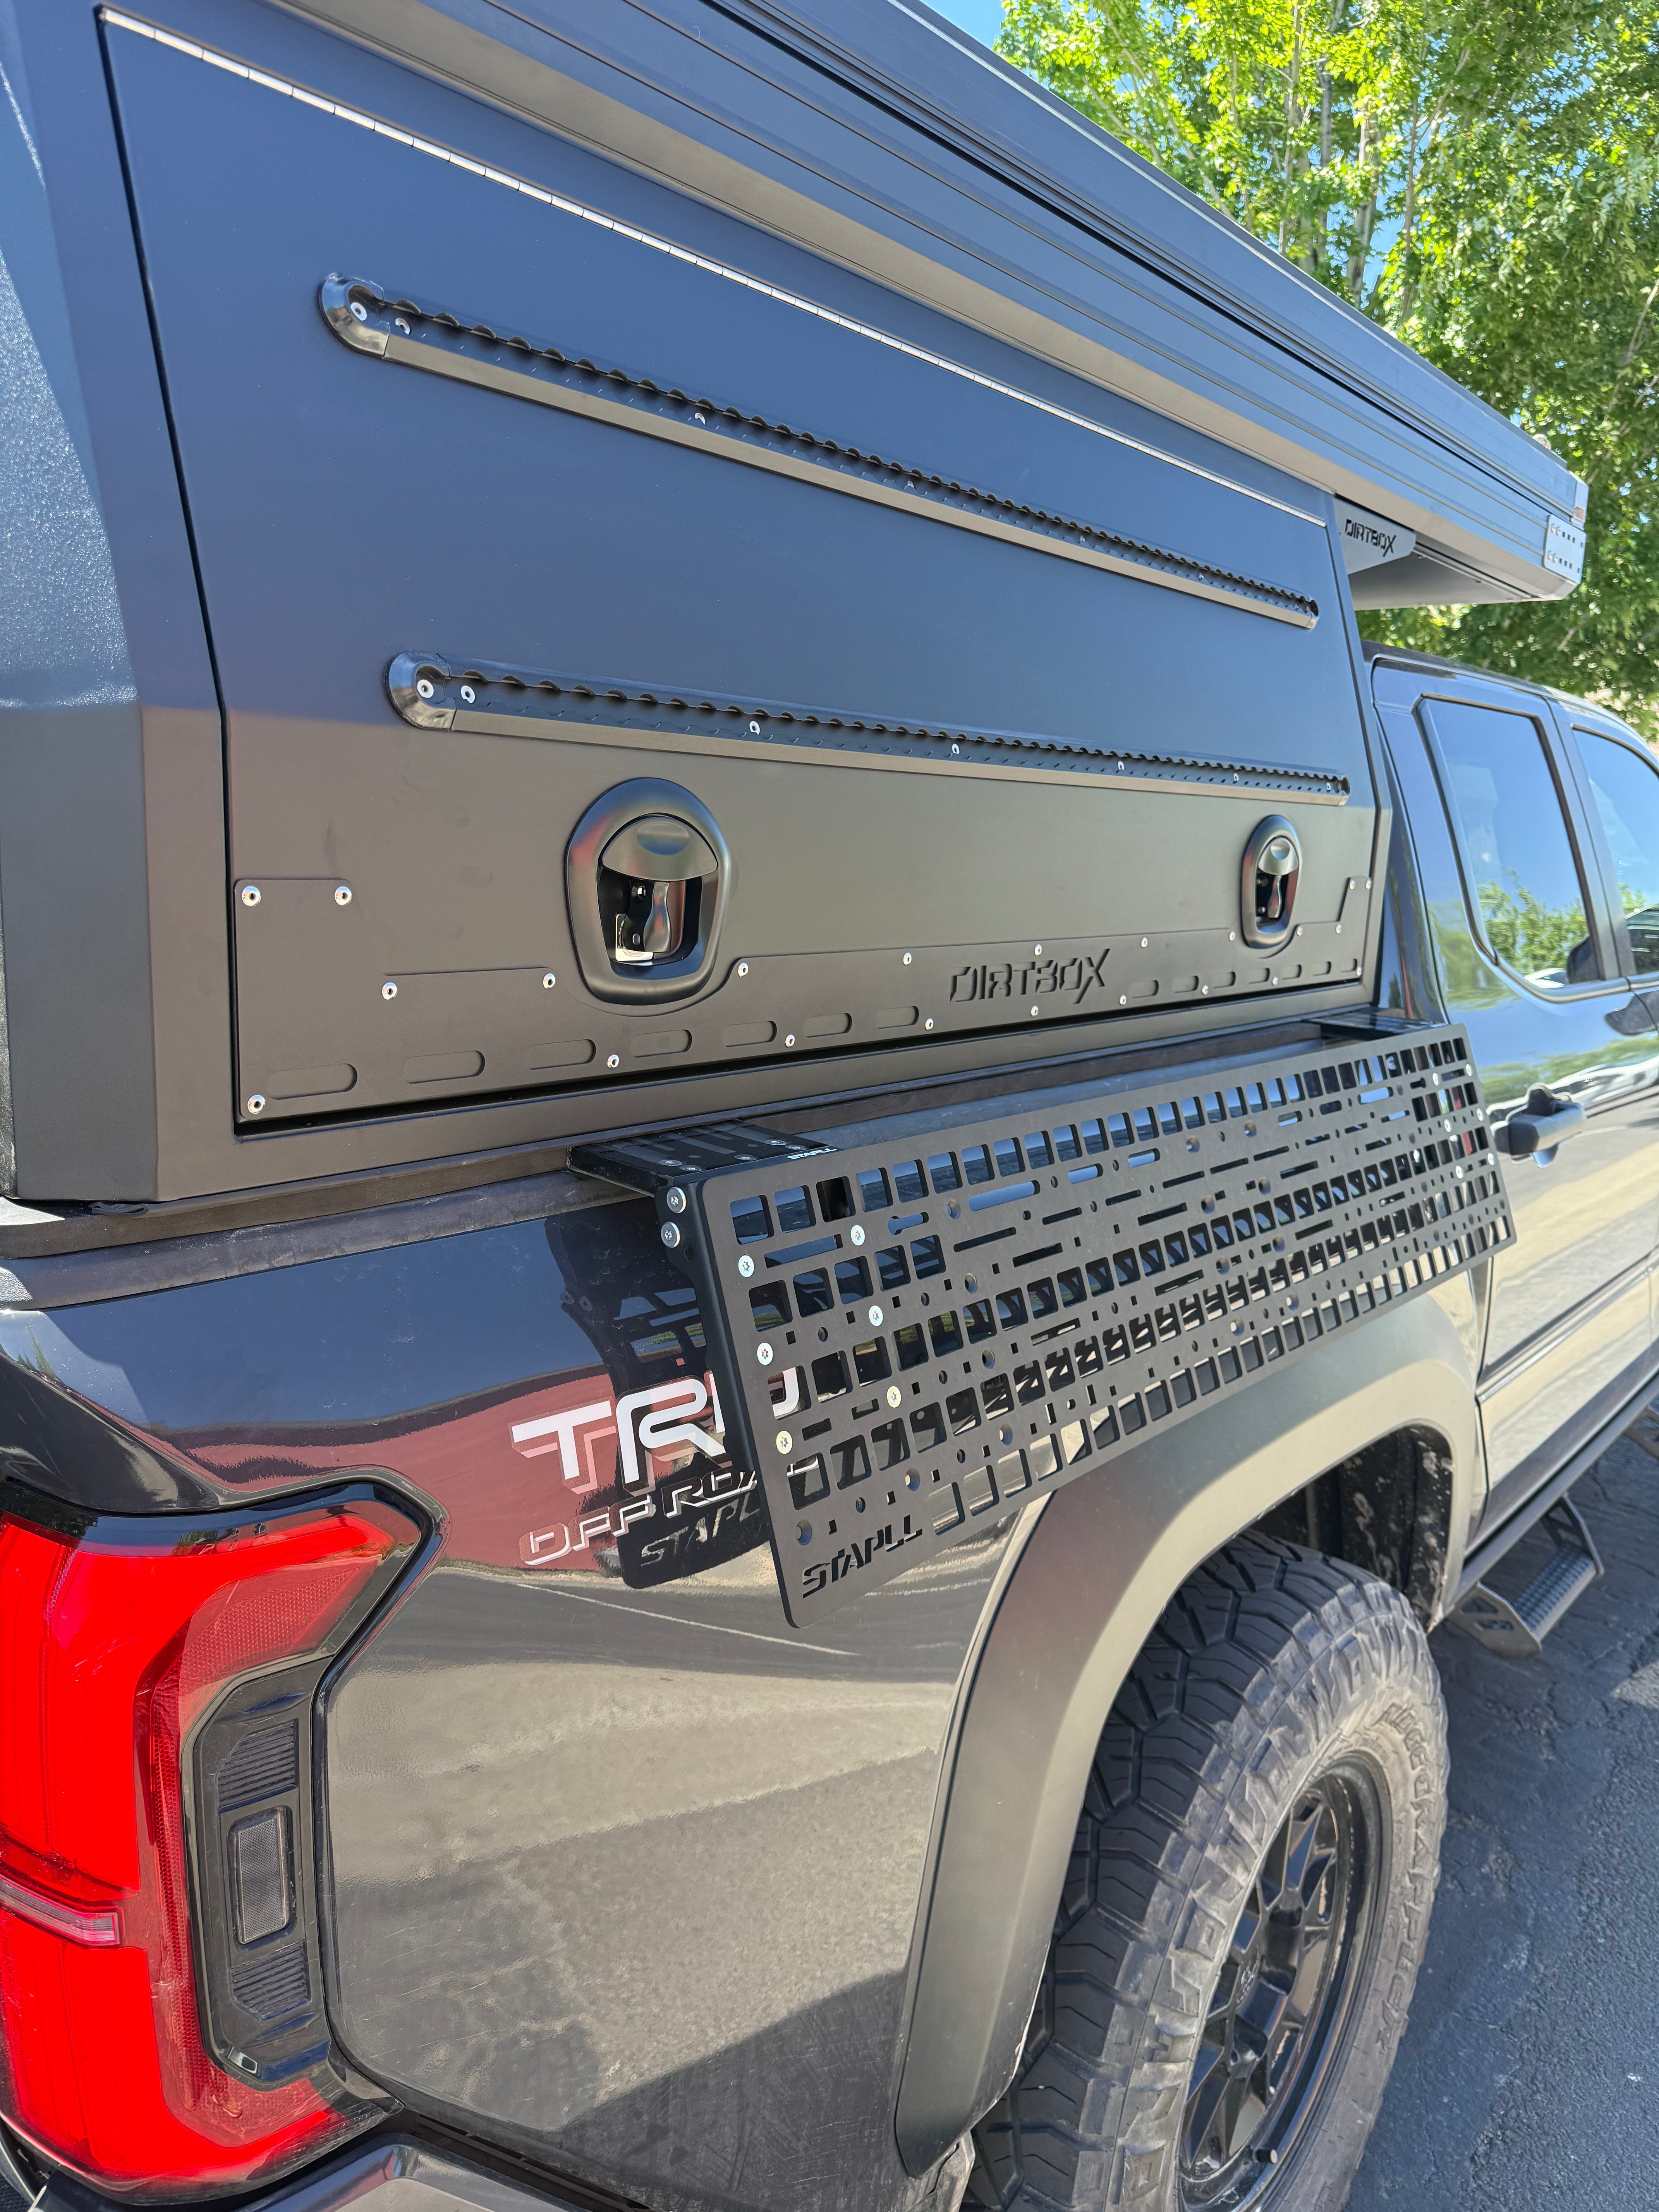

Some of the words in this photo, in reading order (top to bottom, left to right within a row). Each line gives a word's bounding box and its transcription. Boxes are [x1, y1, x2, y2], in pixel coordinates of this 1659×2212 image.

[1344, 519, 1396, 557] DIRTBOX
[949, 948, 1111, 1005] DIRTBOX
[519, 1494, 656, 1566] OFF
[640, 1492, 760, 1567] STAPL
[802, 1515, 923, 1599] STAPLL
